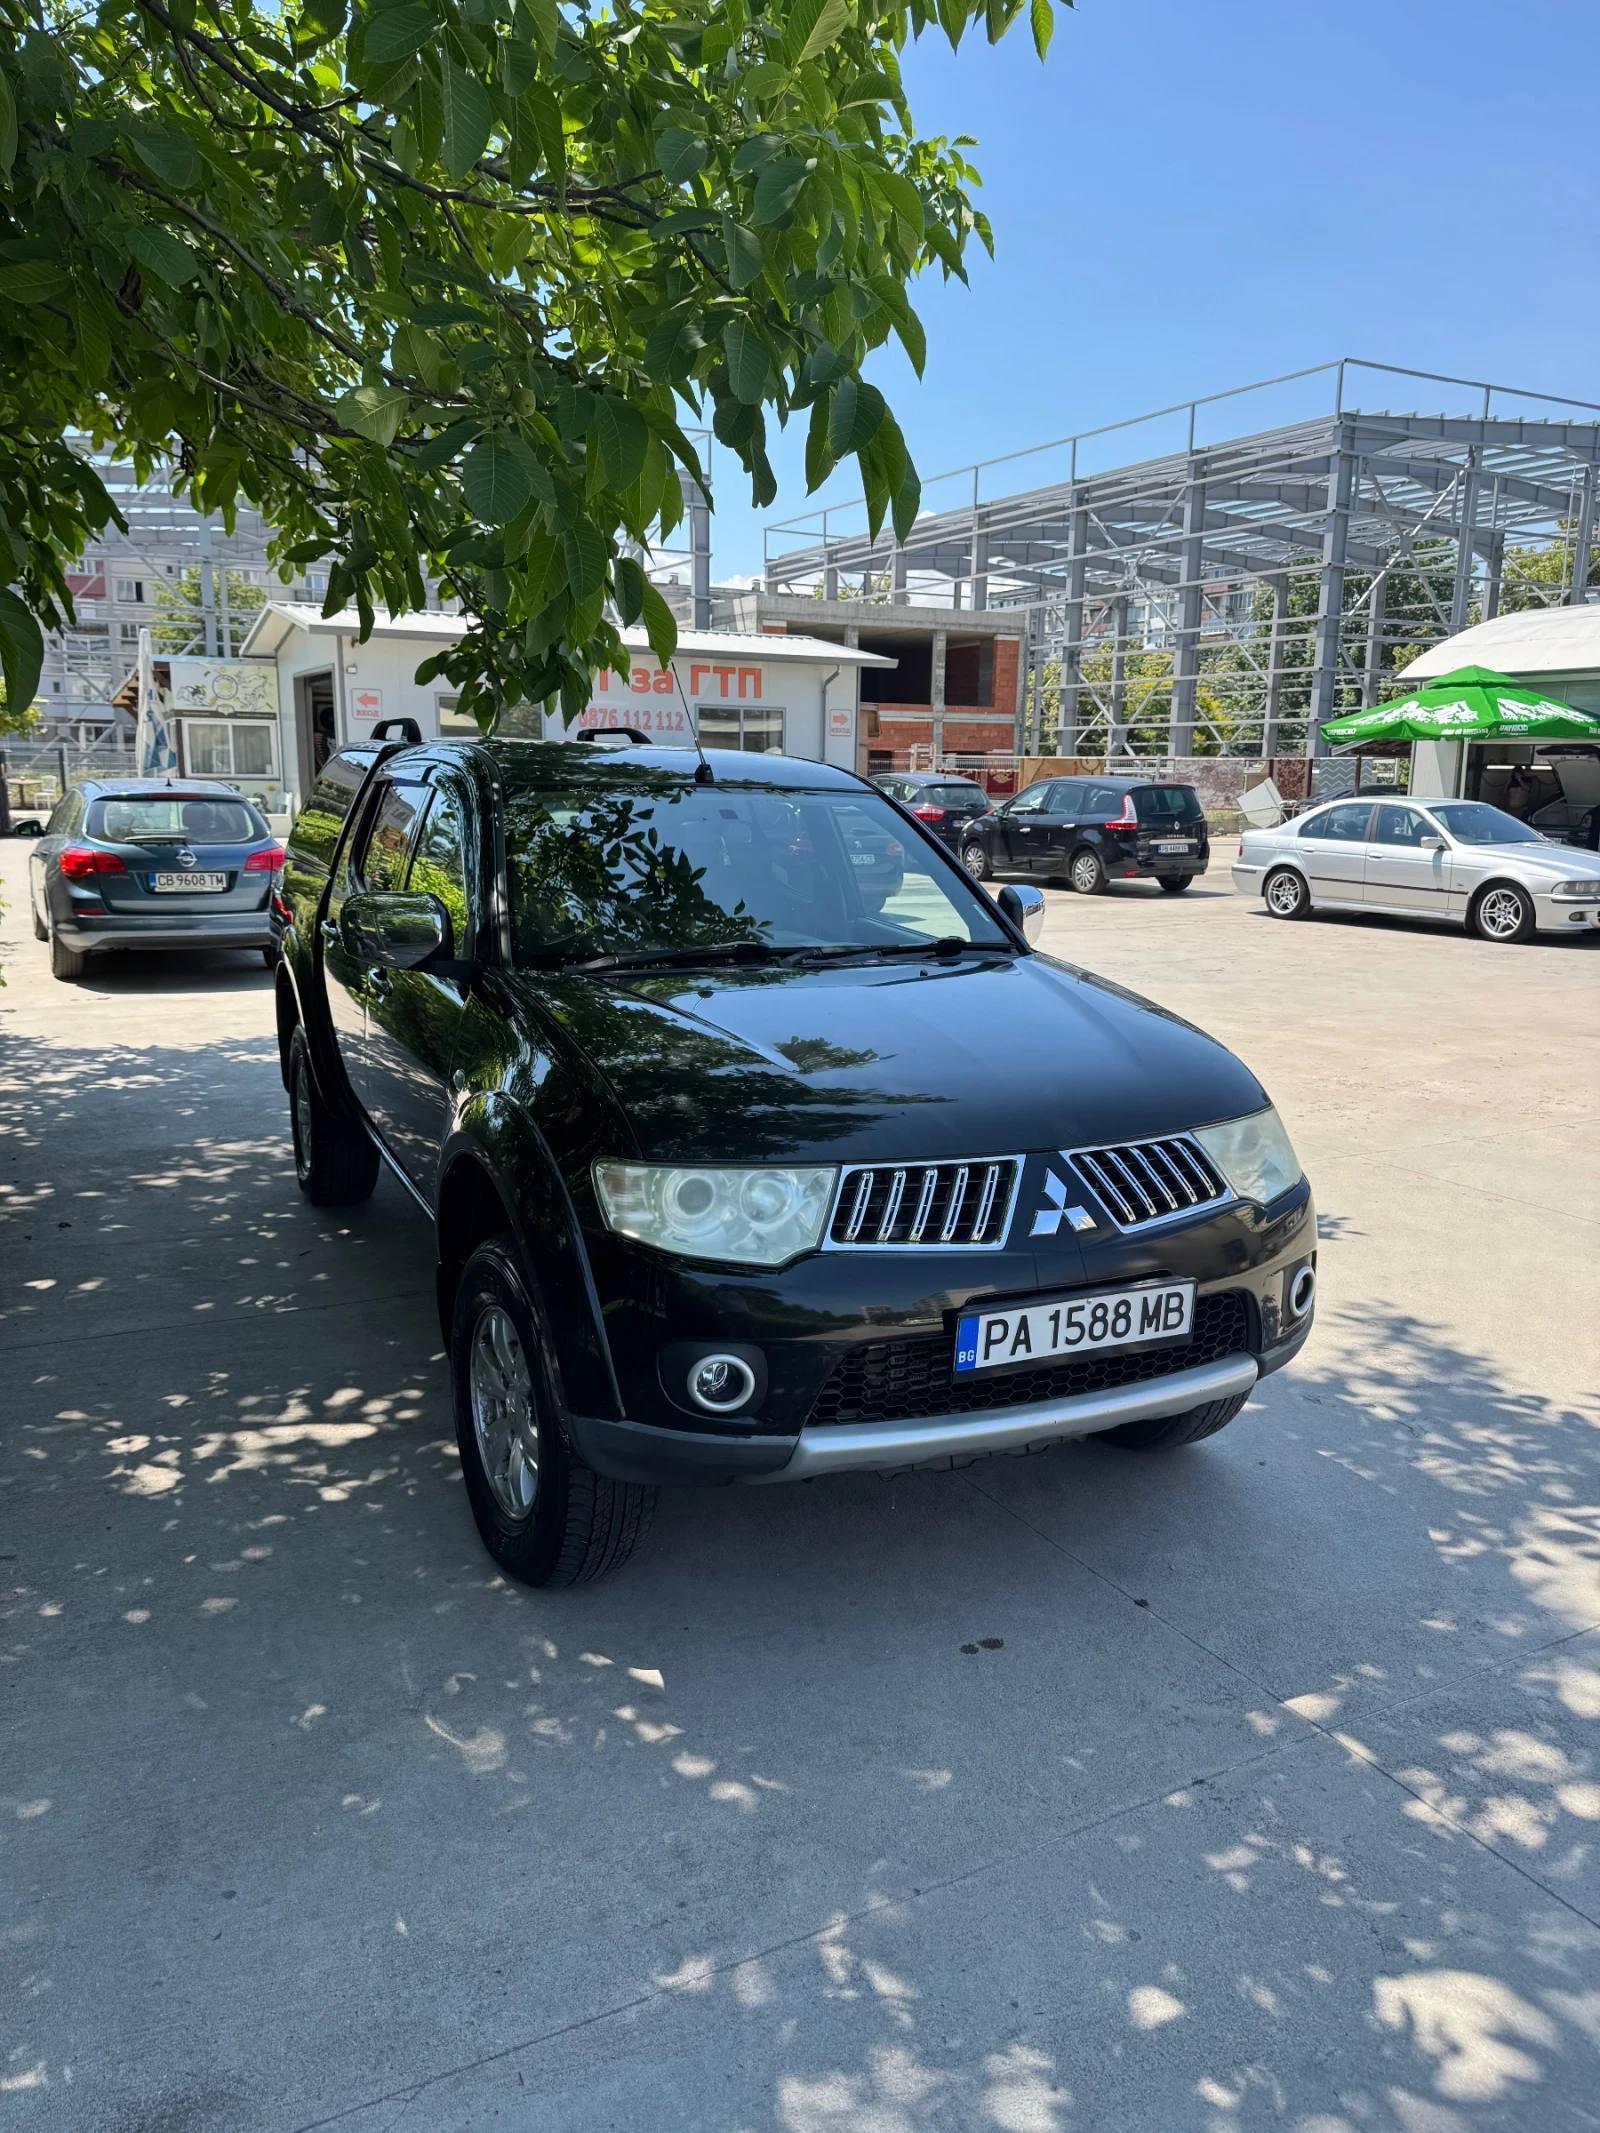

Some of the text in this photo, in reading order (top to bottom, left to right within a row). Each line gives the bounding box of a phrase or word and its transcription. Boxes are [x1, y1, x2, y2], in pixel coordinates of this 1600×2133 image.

[631, 668, 674, 694] за
[690, 665, 762, 698] ГТП
[578, 708, 684, 731] 0876 112 112
[158, 875, 225, 886] CB 9608 TM
[983, 1291, 1185, 1361] PA 1588 MB
[958, 1349, 976, 1363] BG
